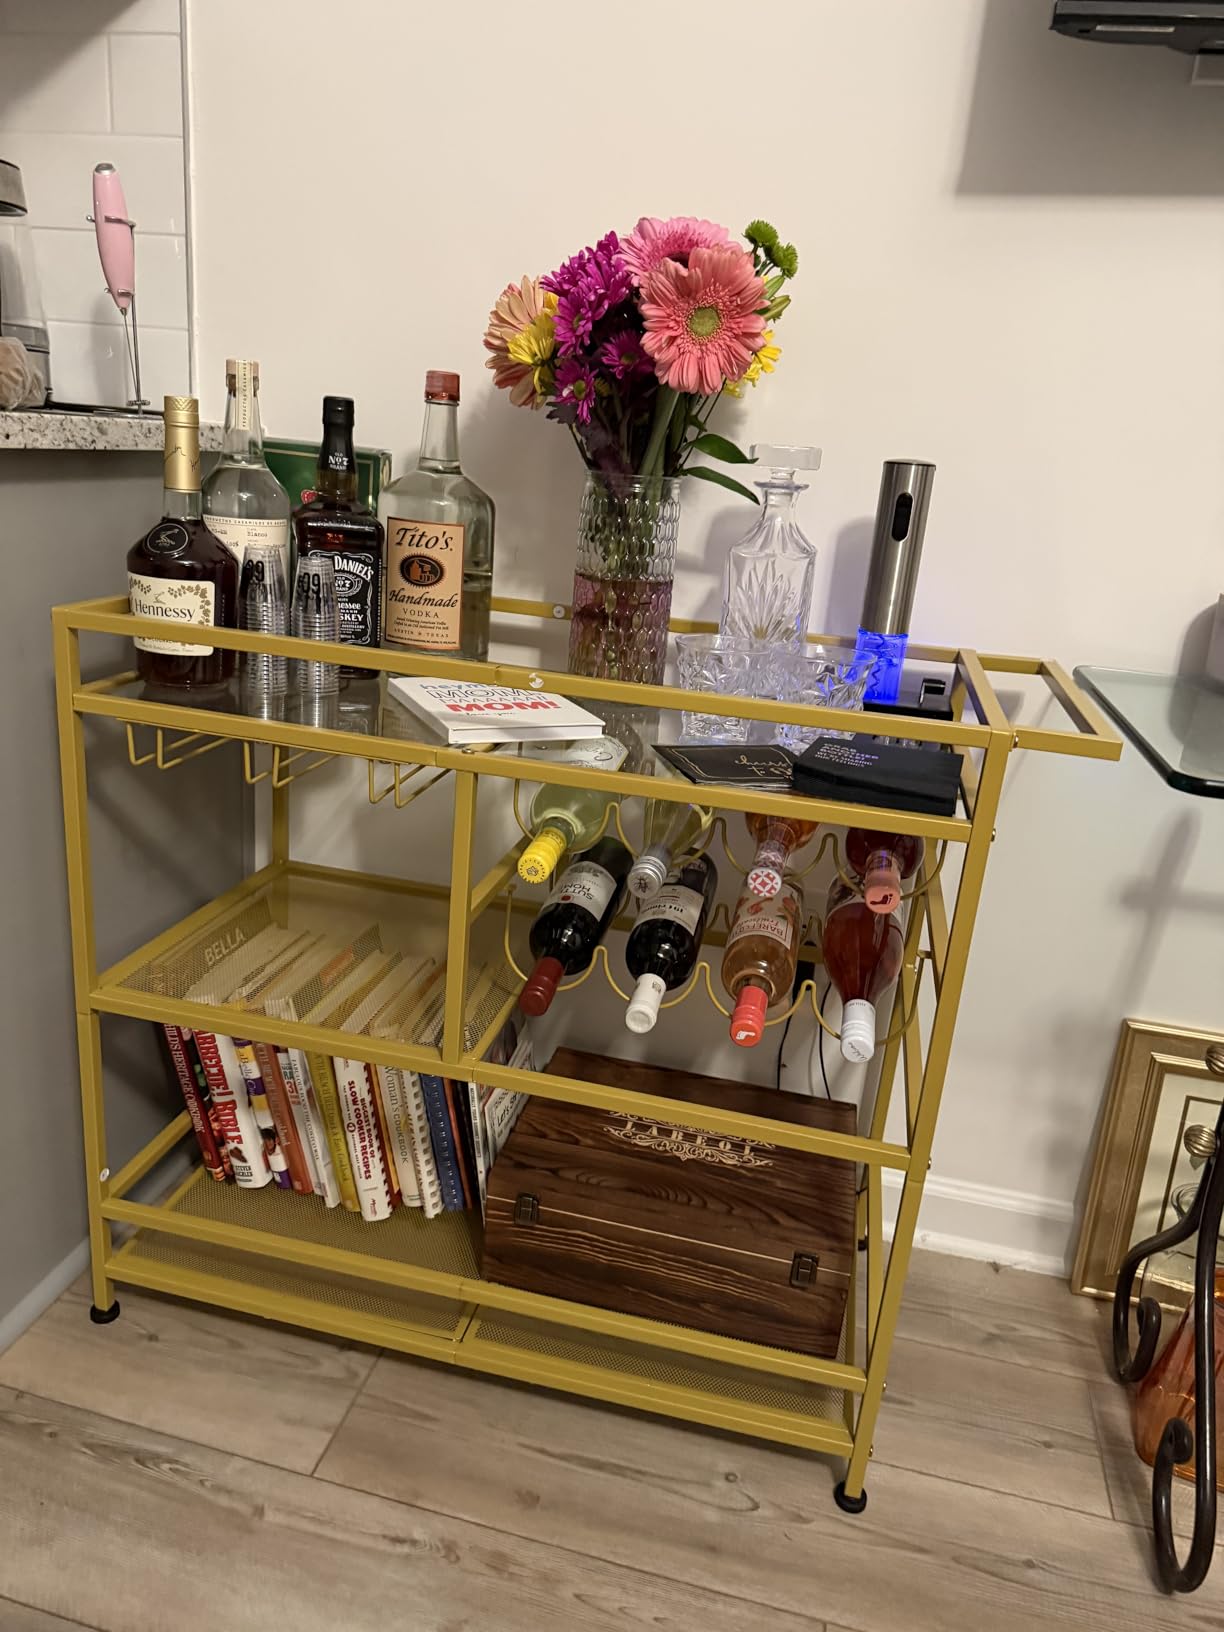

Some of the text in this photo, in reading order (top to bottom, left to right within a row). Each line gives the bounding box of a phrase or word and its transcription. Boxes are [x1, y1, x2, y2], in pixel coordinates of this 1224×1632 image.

[389, 587, 459, 608] Handmade
[135, 598, 195, 622] Hennessy
[403, 608, 439, 619] VODKA
[446, 701, 561, 712] MOM!
[213, 1099, 244, 1146] BIBLE
[348, 1080, 371, 1180] SLOW COOKER RECIPES
[360, 1097, 375, 1158] BIGGEST BOOK OF
